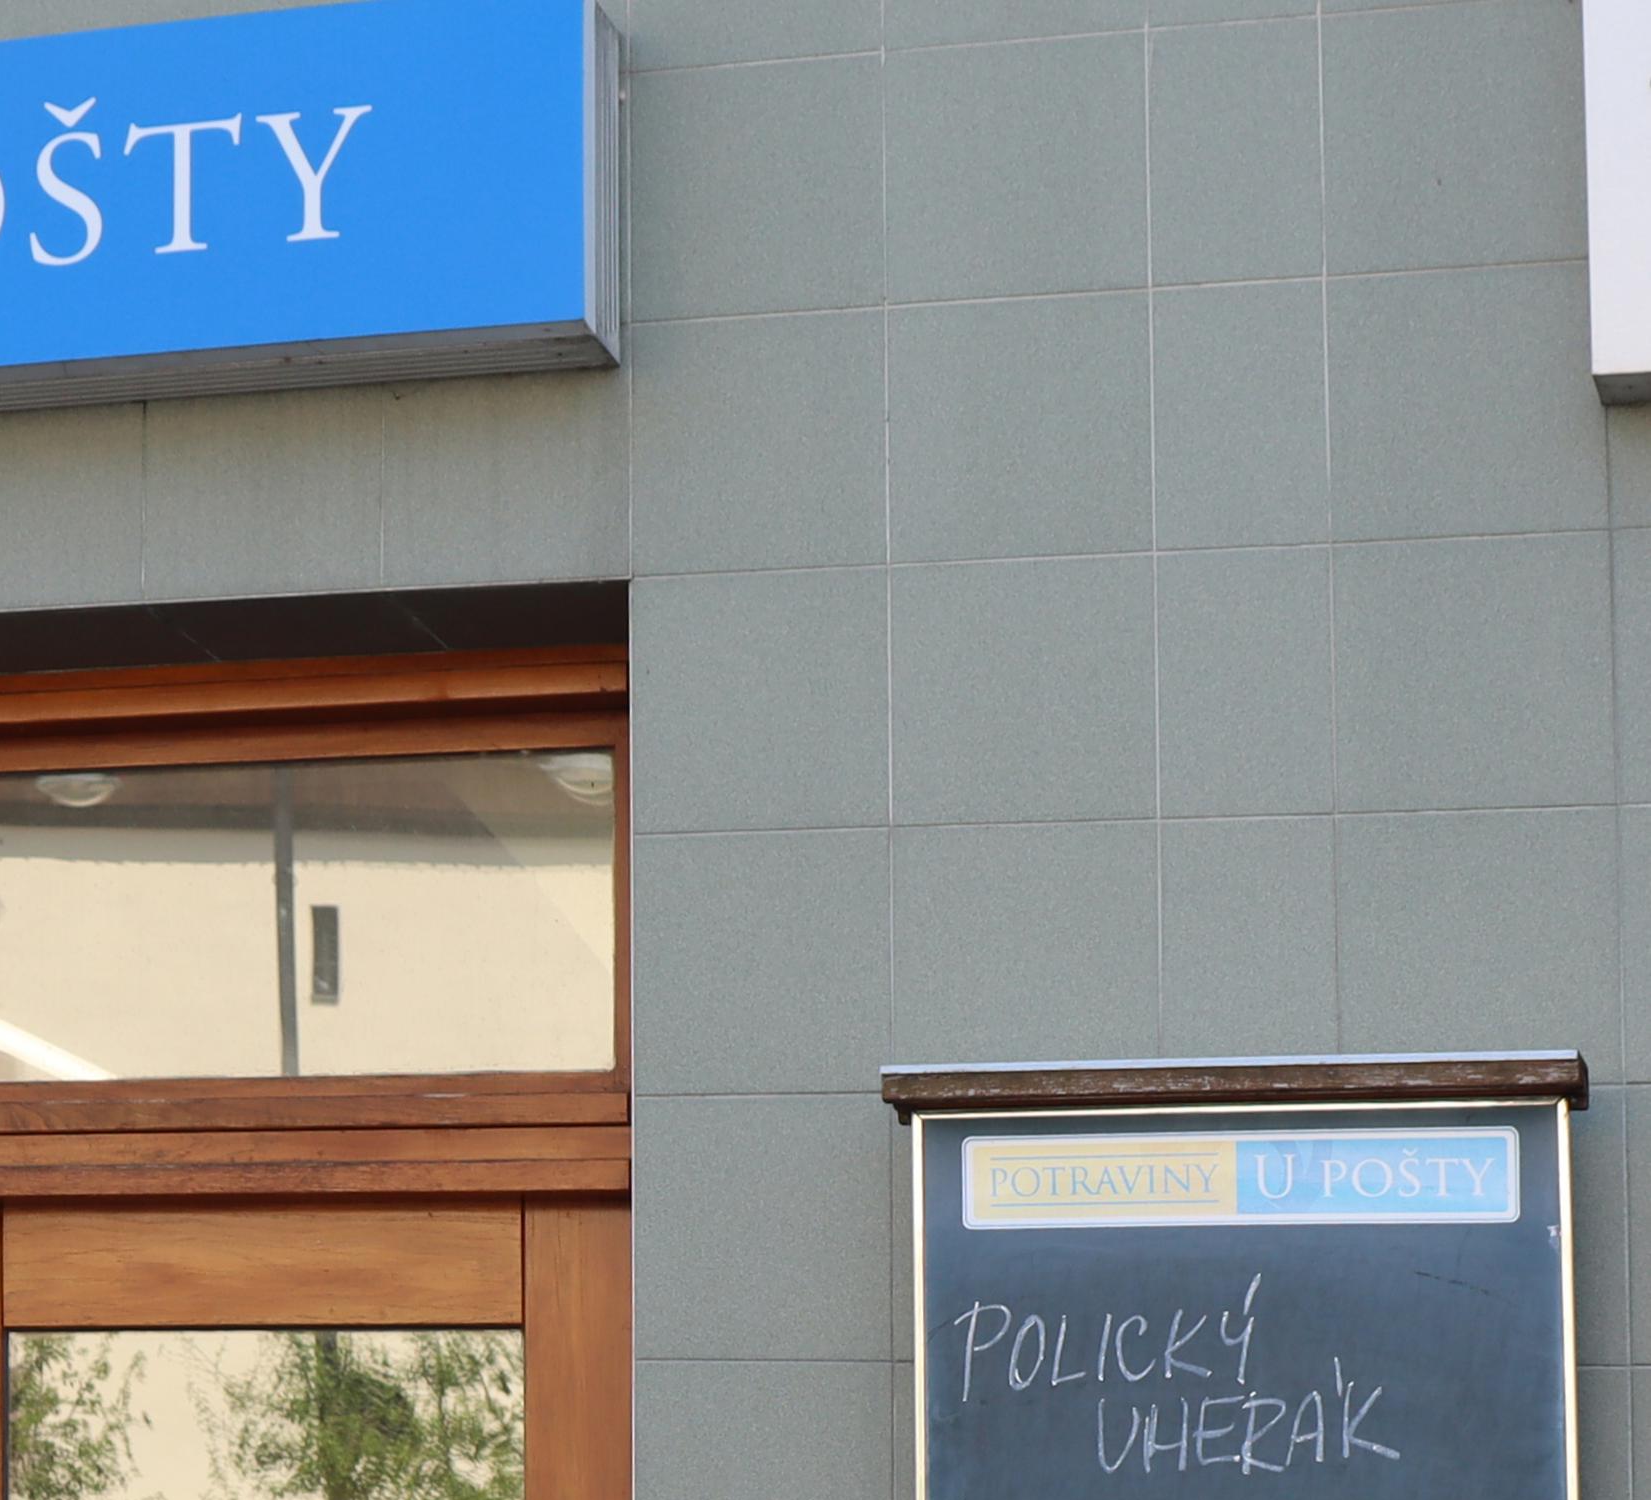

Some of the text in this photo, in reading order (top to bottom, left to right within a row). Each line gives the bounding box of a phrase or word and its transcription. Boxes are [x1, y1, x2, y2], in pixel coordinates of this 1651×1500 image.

[990, 1149, 1495, 1199] POTRAVINY U POŠTY
[954, 1273, 1261, 1402] POLICKÝ
[1098, 1356, 1400, 1475] UHERÁK
